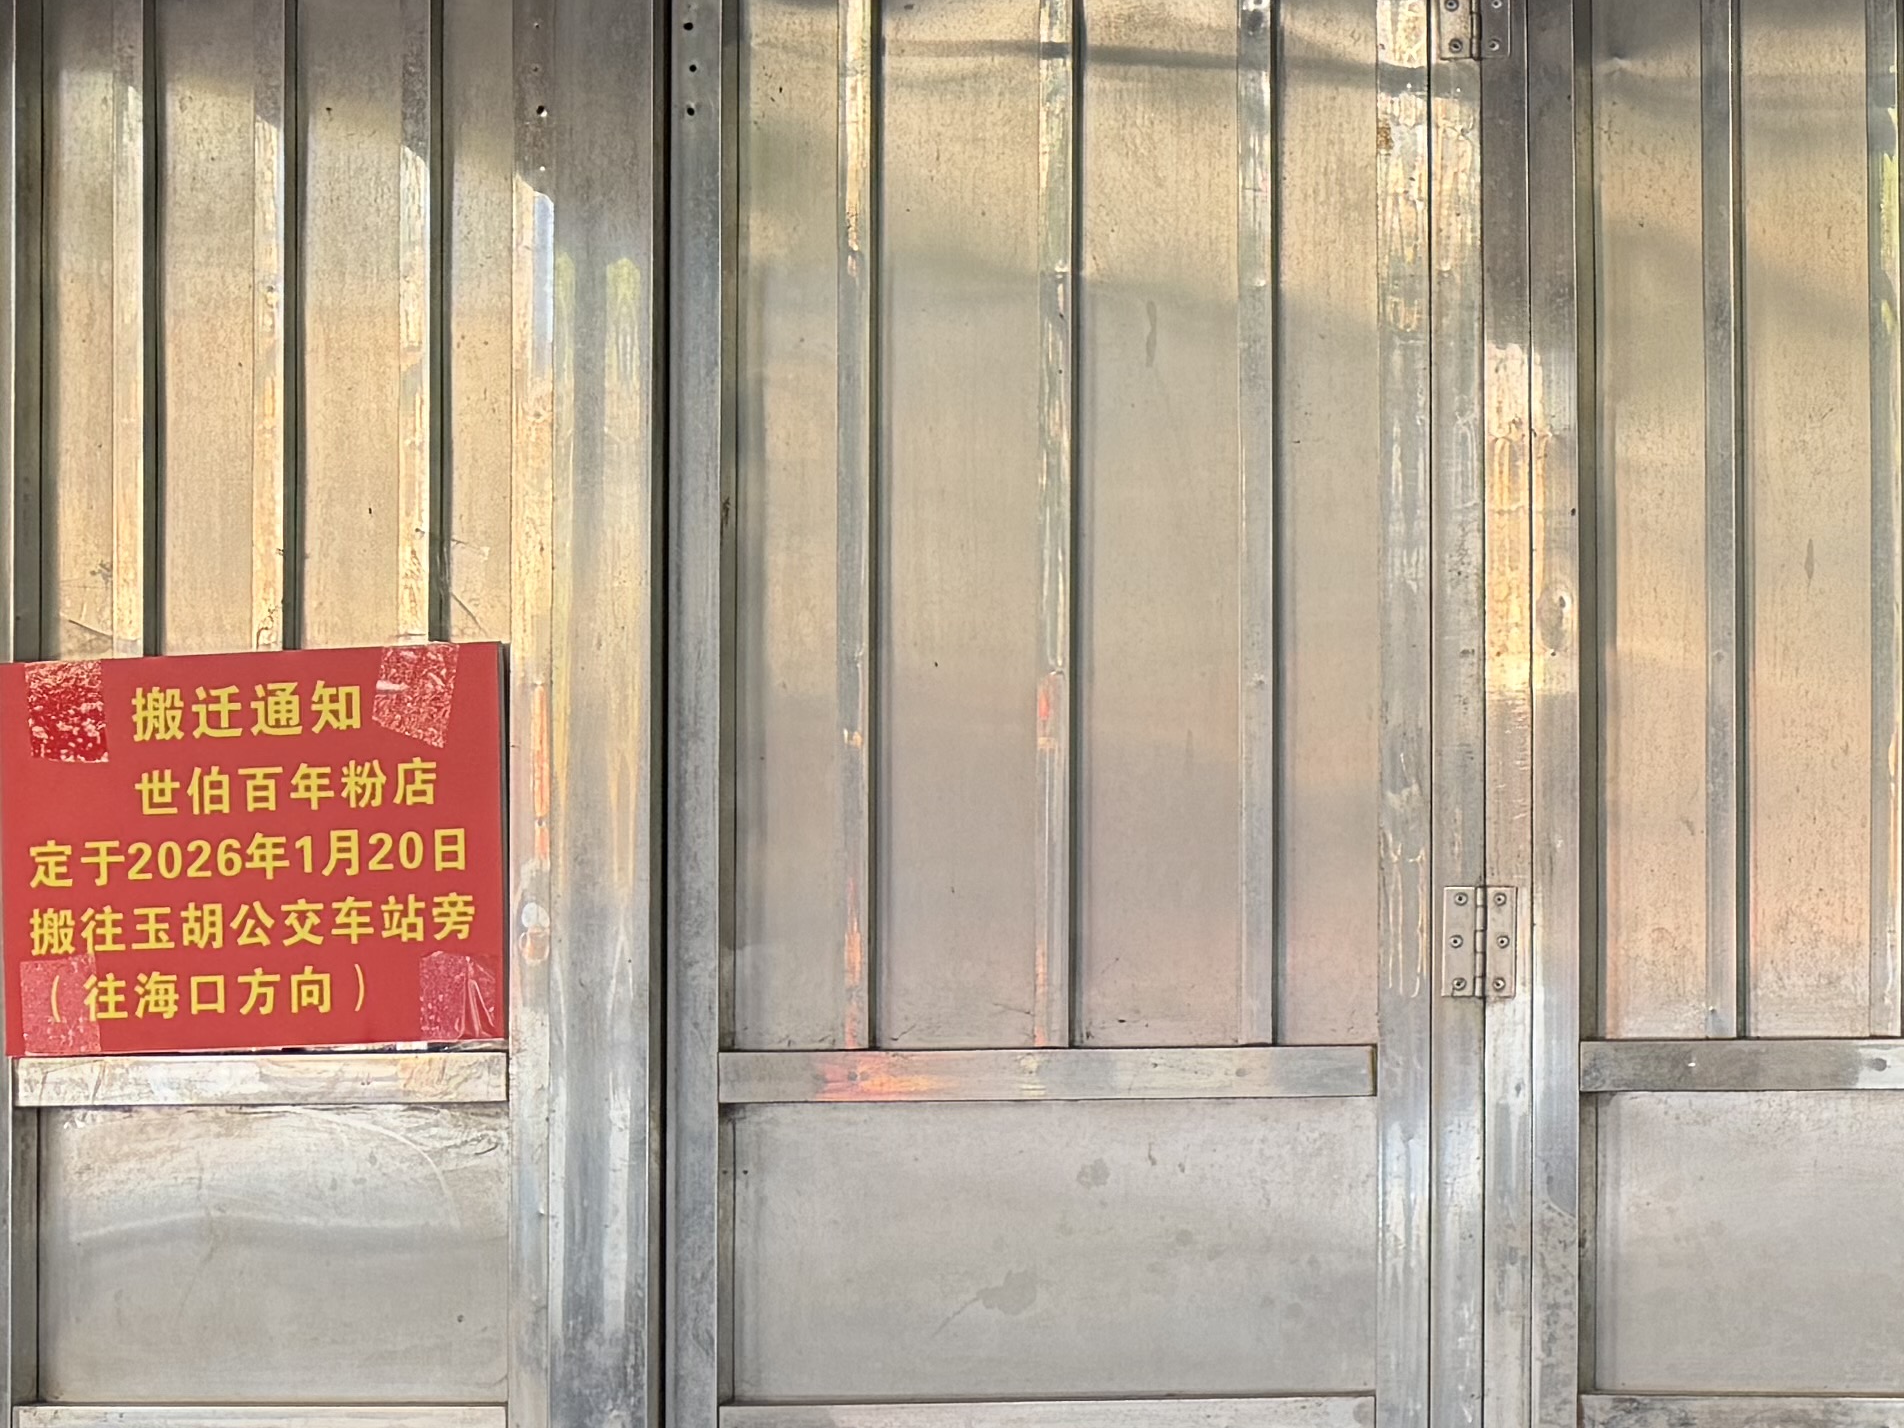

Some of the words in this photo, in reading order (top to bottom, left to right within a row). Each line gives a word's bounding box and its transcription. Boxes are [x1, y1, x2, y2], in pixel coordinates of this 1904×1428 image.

[132, 681, 363, 743] 搬迁通知
[134, 757, 438, 816] 世伯百年粉店
[29, 828, 468, 889] 定于2026年1月20日
[30, 893, 476, 957] 搬往玉胡公交车站旁
